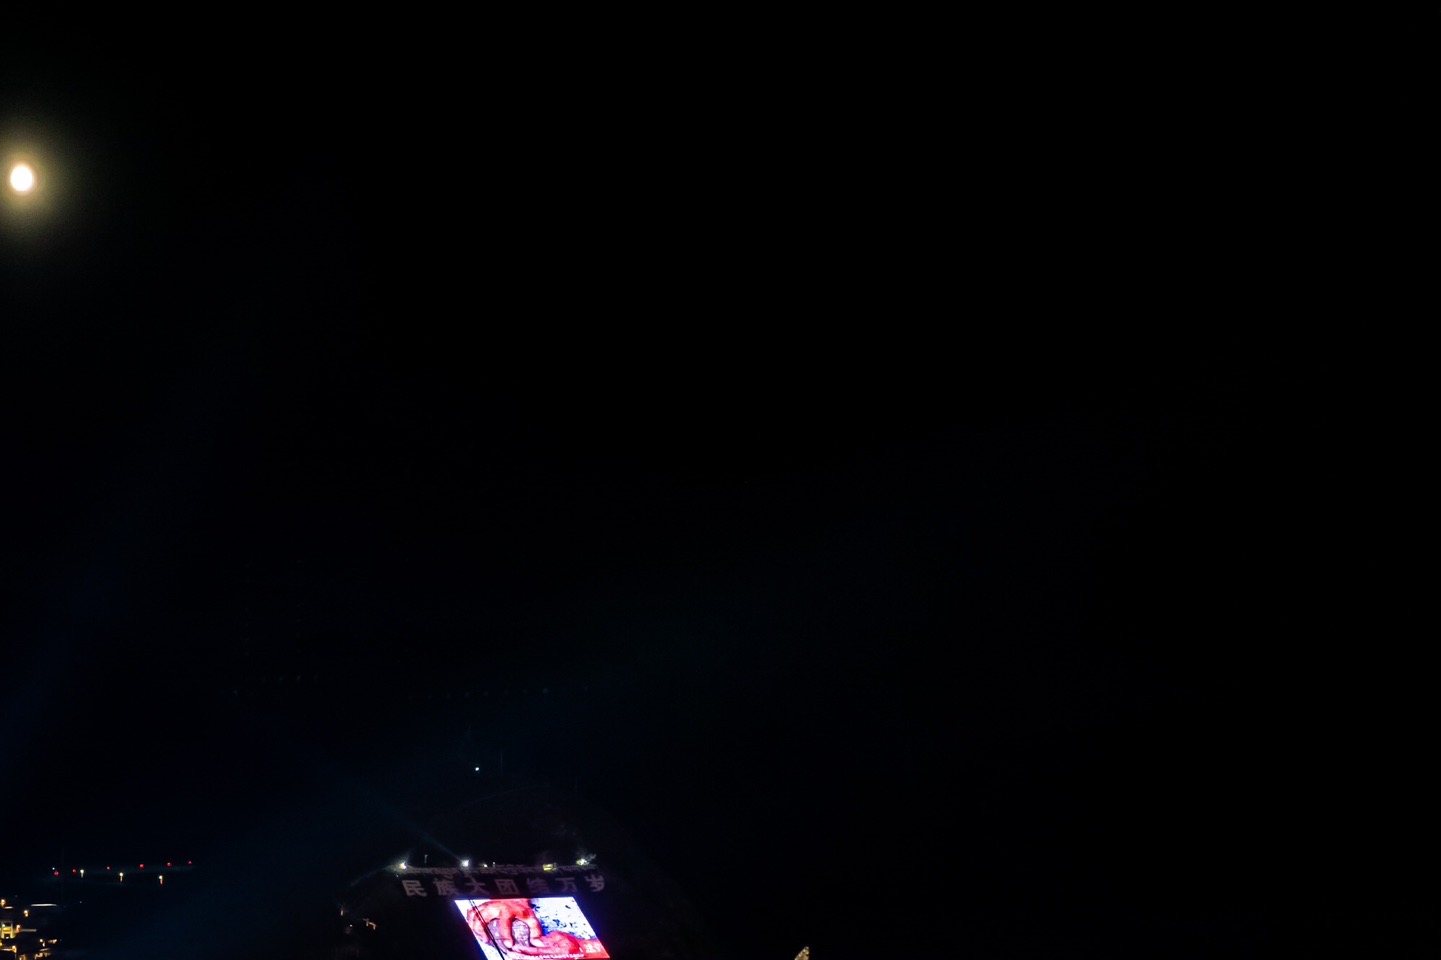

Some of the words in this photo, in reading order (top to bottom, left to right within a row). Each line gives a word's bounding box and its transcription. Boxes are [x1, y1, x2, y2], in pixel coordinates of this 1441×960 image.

[401, 874, 606, 898] 民族大团结万岁
